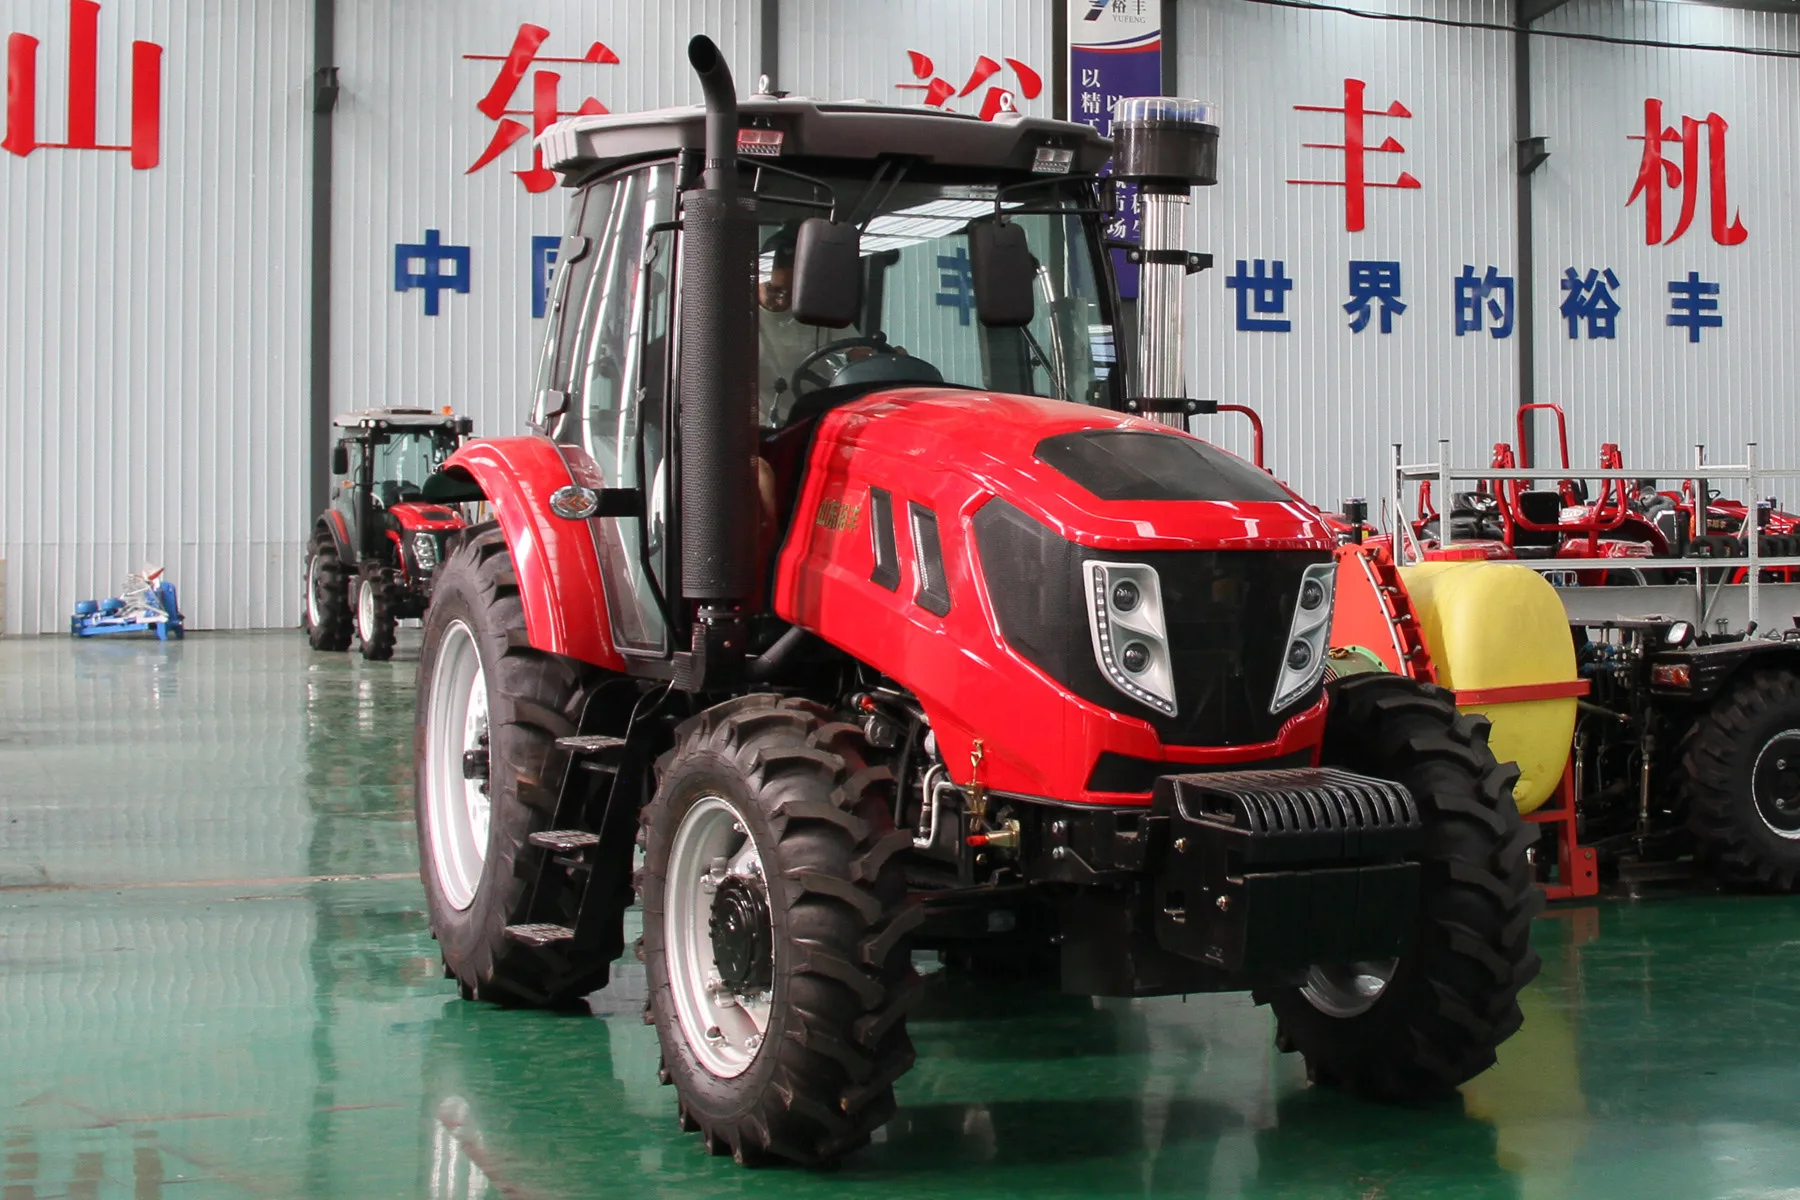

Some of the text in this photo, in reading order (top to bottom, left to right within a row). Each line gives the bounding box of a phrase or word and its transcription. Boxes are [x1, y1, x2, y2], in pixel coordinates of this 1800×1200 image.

[1112, 14, 1146, 23] YUFENG
[1226, 259, 1723, 343] 世界的裕丰
